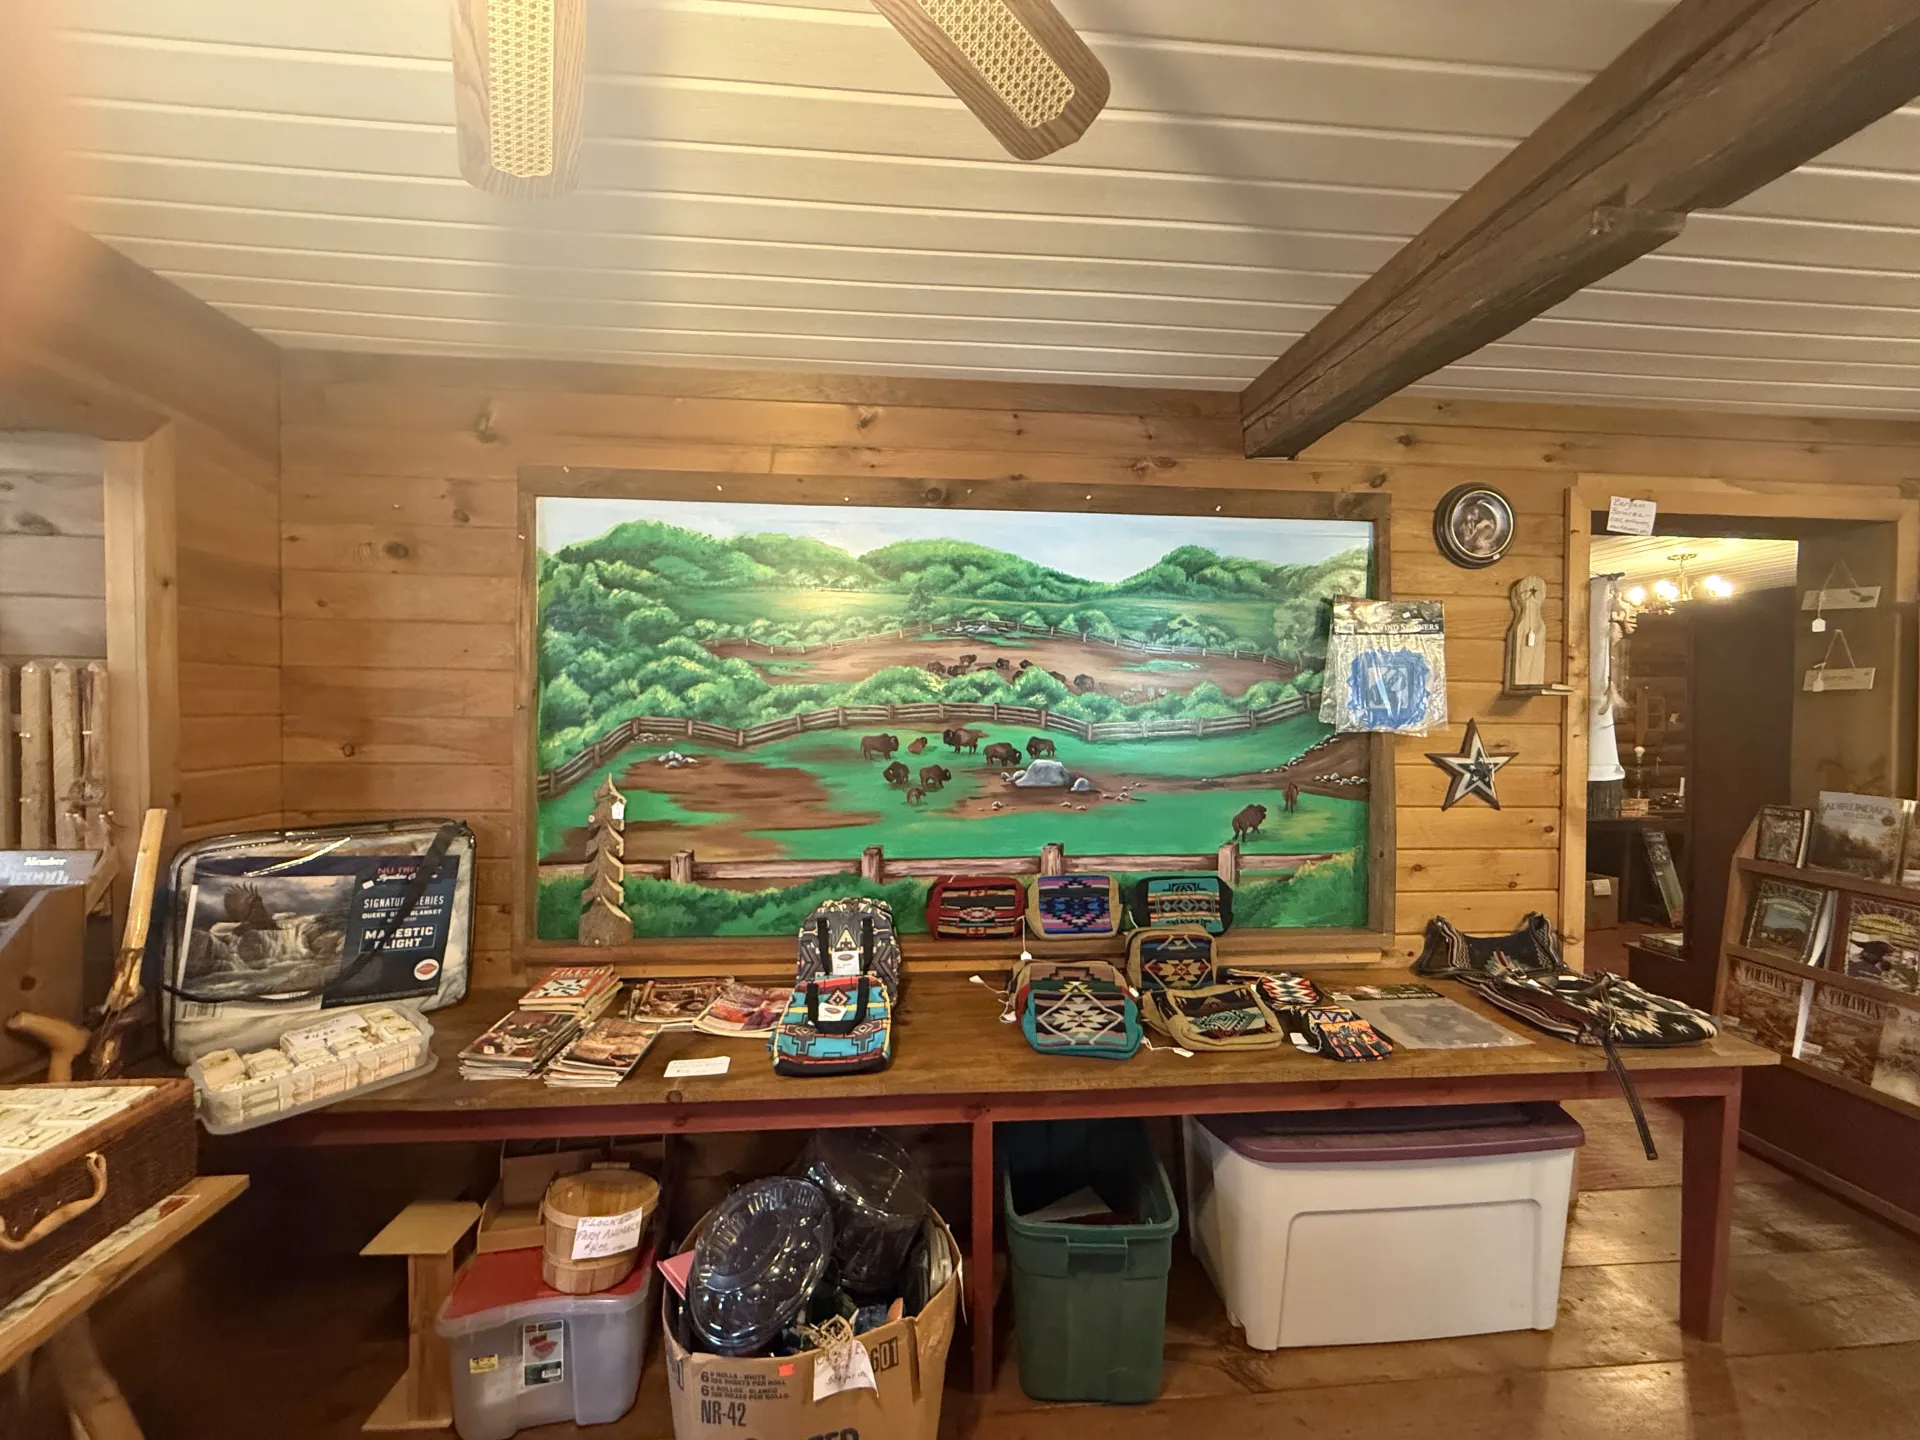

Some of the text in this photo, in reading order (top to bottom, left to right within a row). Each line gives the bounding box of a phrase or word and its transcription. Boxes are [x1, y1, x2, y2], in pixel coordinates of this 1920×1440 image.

[1376, 623, 1399, 632] WIND
[415, 895, 445, 907] ERIES
[361, 911, 387, 919] QUEEN
[410, 908, 443, 917] BLANKET
[701, 1400, 747, 1427] NR-42
